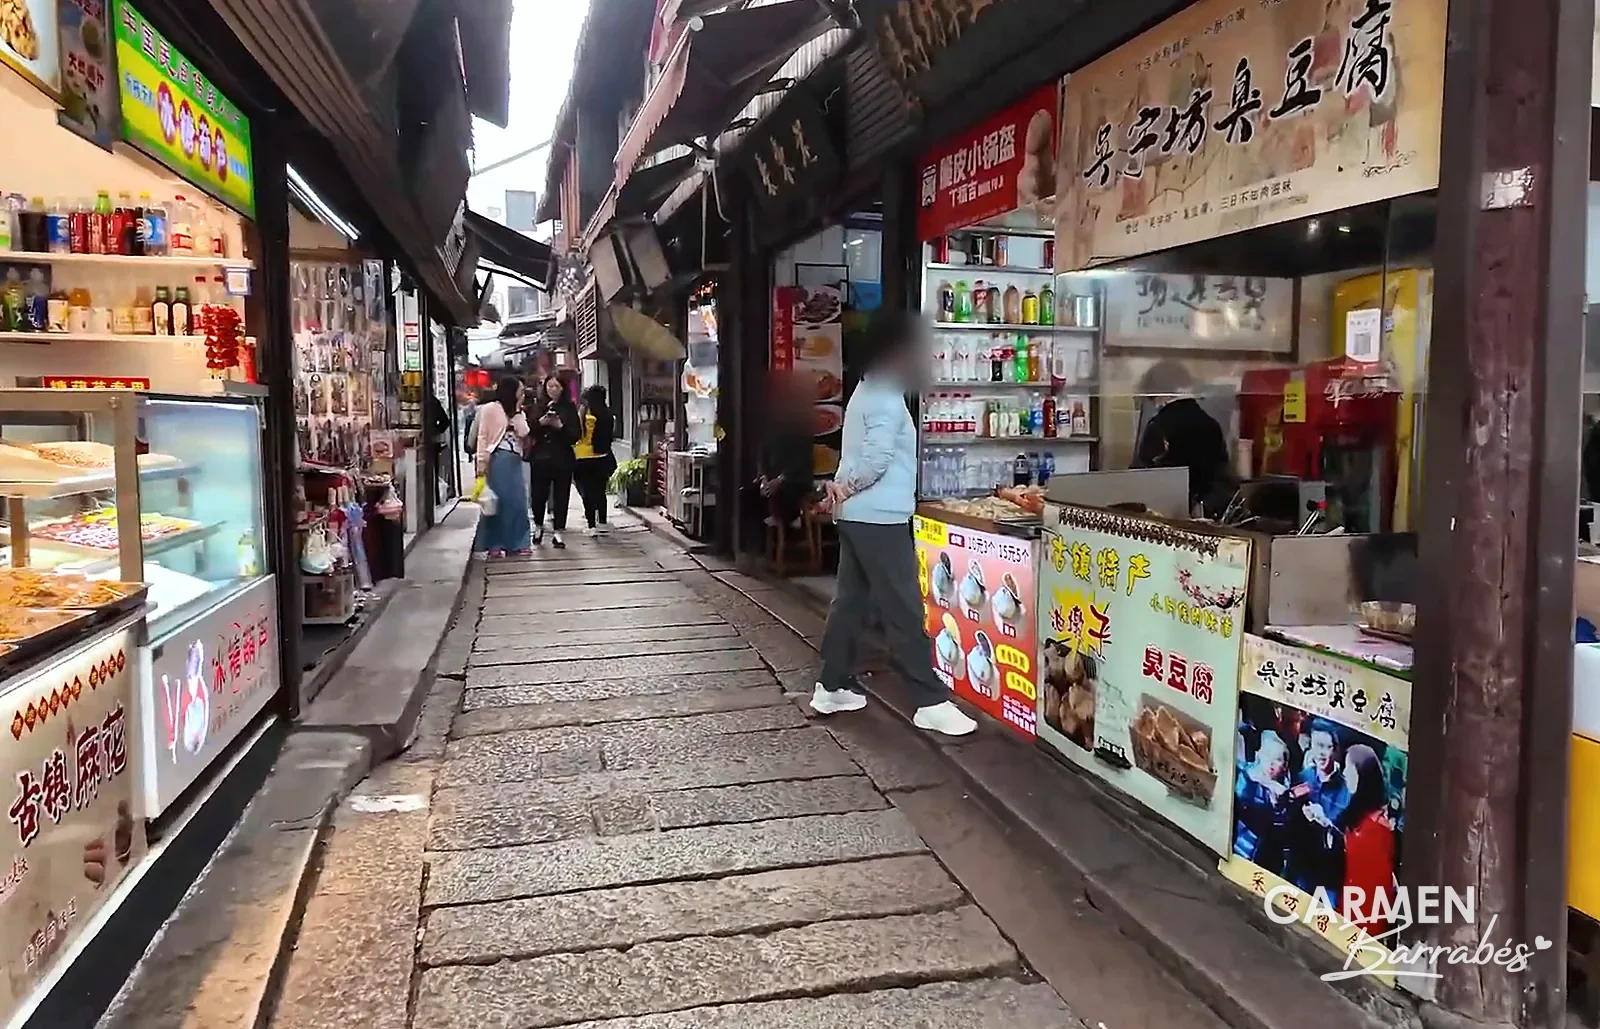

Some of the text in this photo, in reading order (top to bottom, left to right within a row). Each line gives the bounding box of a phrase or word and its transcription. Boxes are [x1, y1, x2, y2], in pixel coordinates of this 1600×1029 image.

[1051, 534, 1151, 596] 古镇特产
[1142, 644, 1214, 706] 臭豆腐
[8, 702, 128, 848] 古镇麻花
